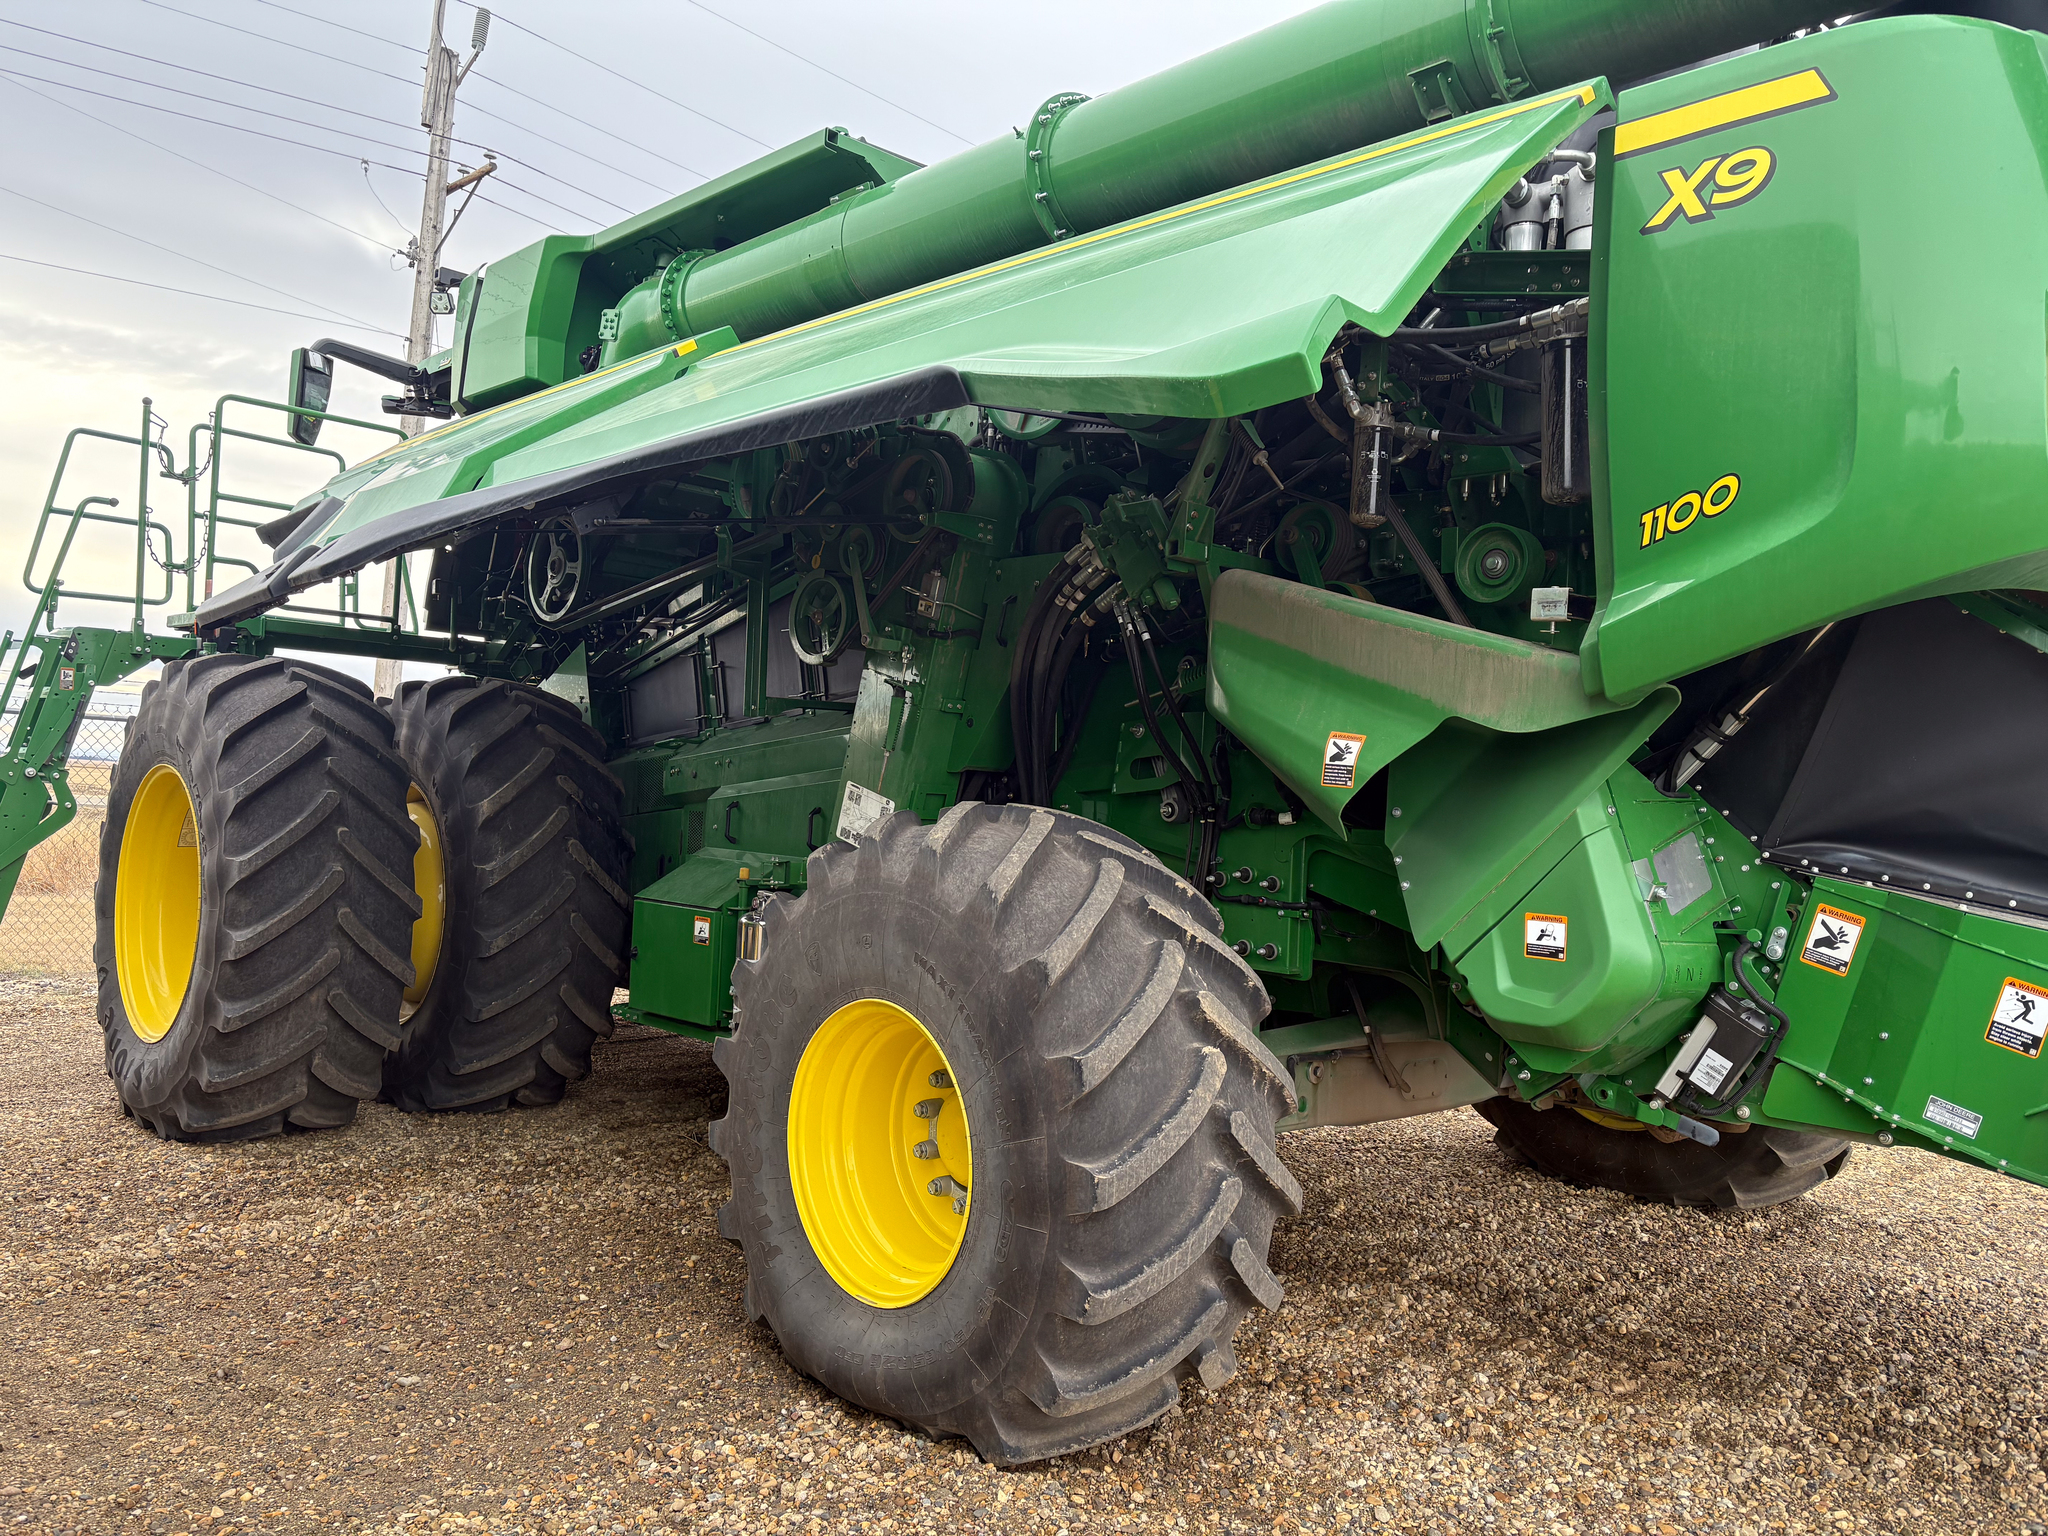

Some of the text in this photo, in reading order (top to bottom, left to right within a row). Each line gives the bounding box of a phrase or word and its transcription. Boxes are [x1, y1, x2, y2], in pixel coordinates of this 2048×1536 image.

[1639, 146, 1777, 236] X9
[1639, 472, 1741, 550] 1100
[1536, 915, 1563, 923] WARNING
[1828, 908, 1862, 925] WARNING
[913, 951, 955, 1000] MAXI
[1993, 1022, 2033, 1040] Avoid serious injury
[744, 973, 798, 1279] Firestone
[1934, 1100, 1953, 1111] JOHN
[1953, 1107, 1976, 1120] DEERE
